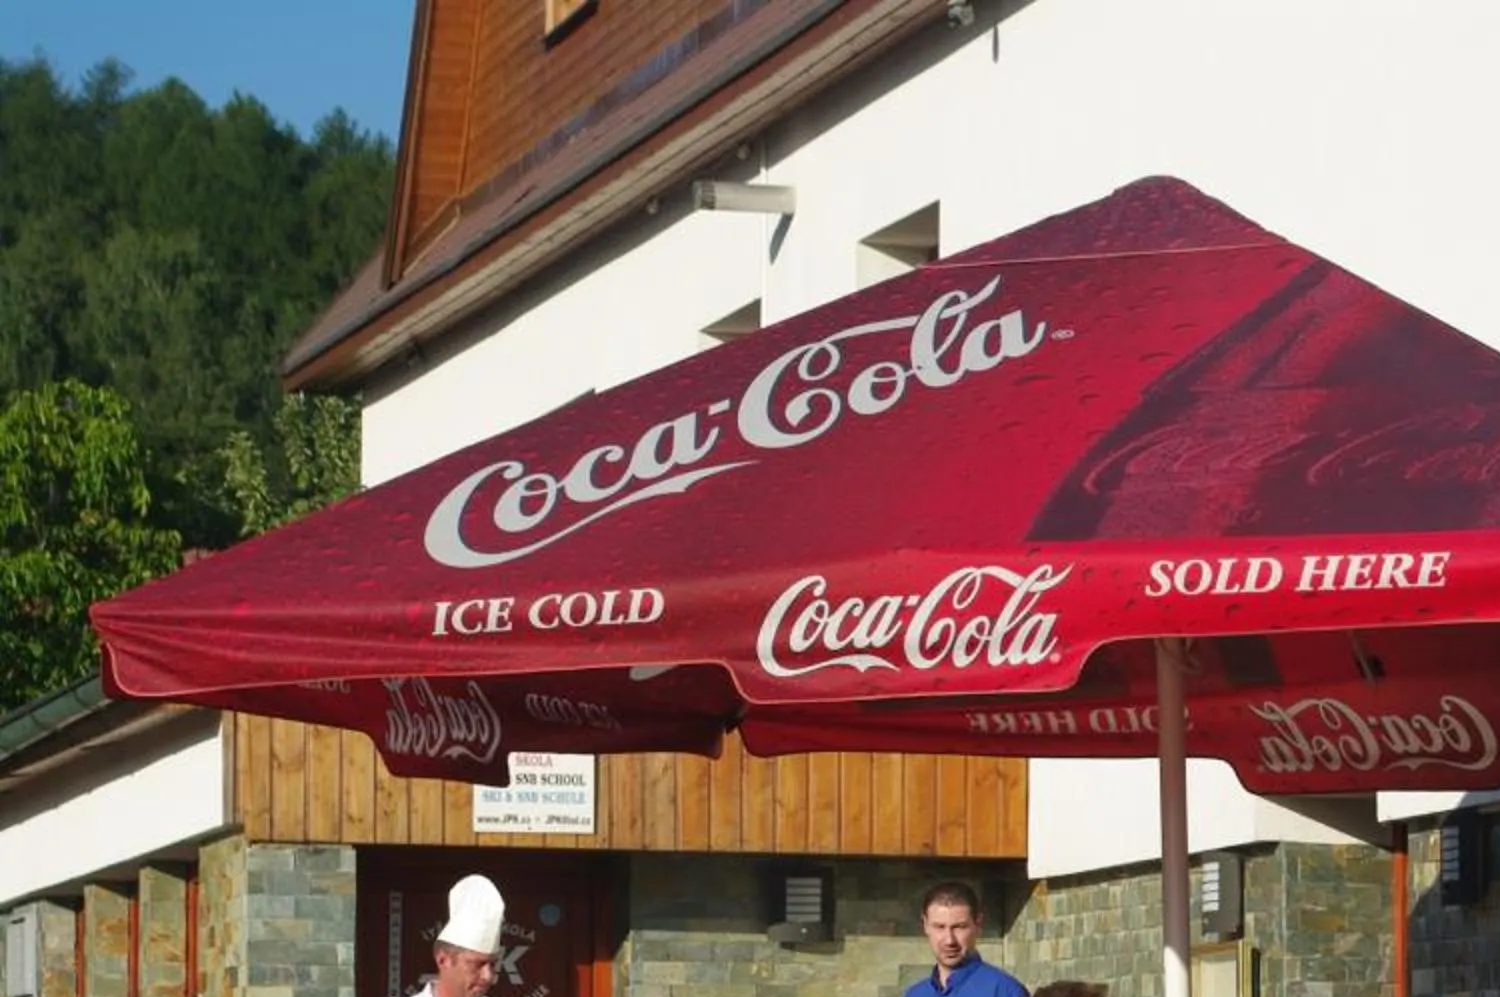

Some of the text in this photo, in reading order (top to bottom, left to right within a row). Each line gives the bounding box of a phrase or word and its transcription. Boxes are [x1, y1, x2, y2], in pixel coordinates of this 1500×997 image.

[424, 275, 1046, 568] Coca-Cola
[432, 551, 1450, 677] ICE COLD Coca-Cola SOLD HERE
[540, 773, 587, 787] SCHOOL
[500, 921, 537, 943] KOLA
